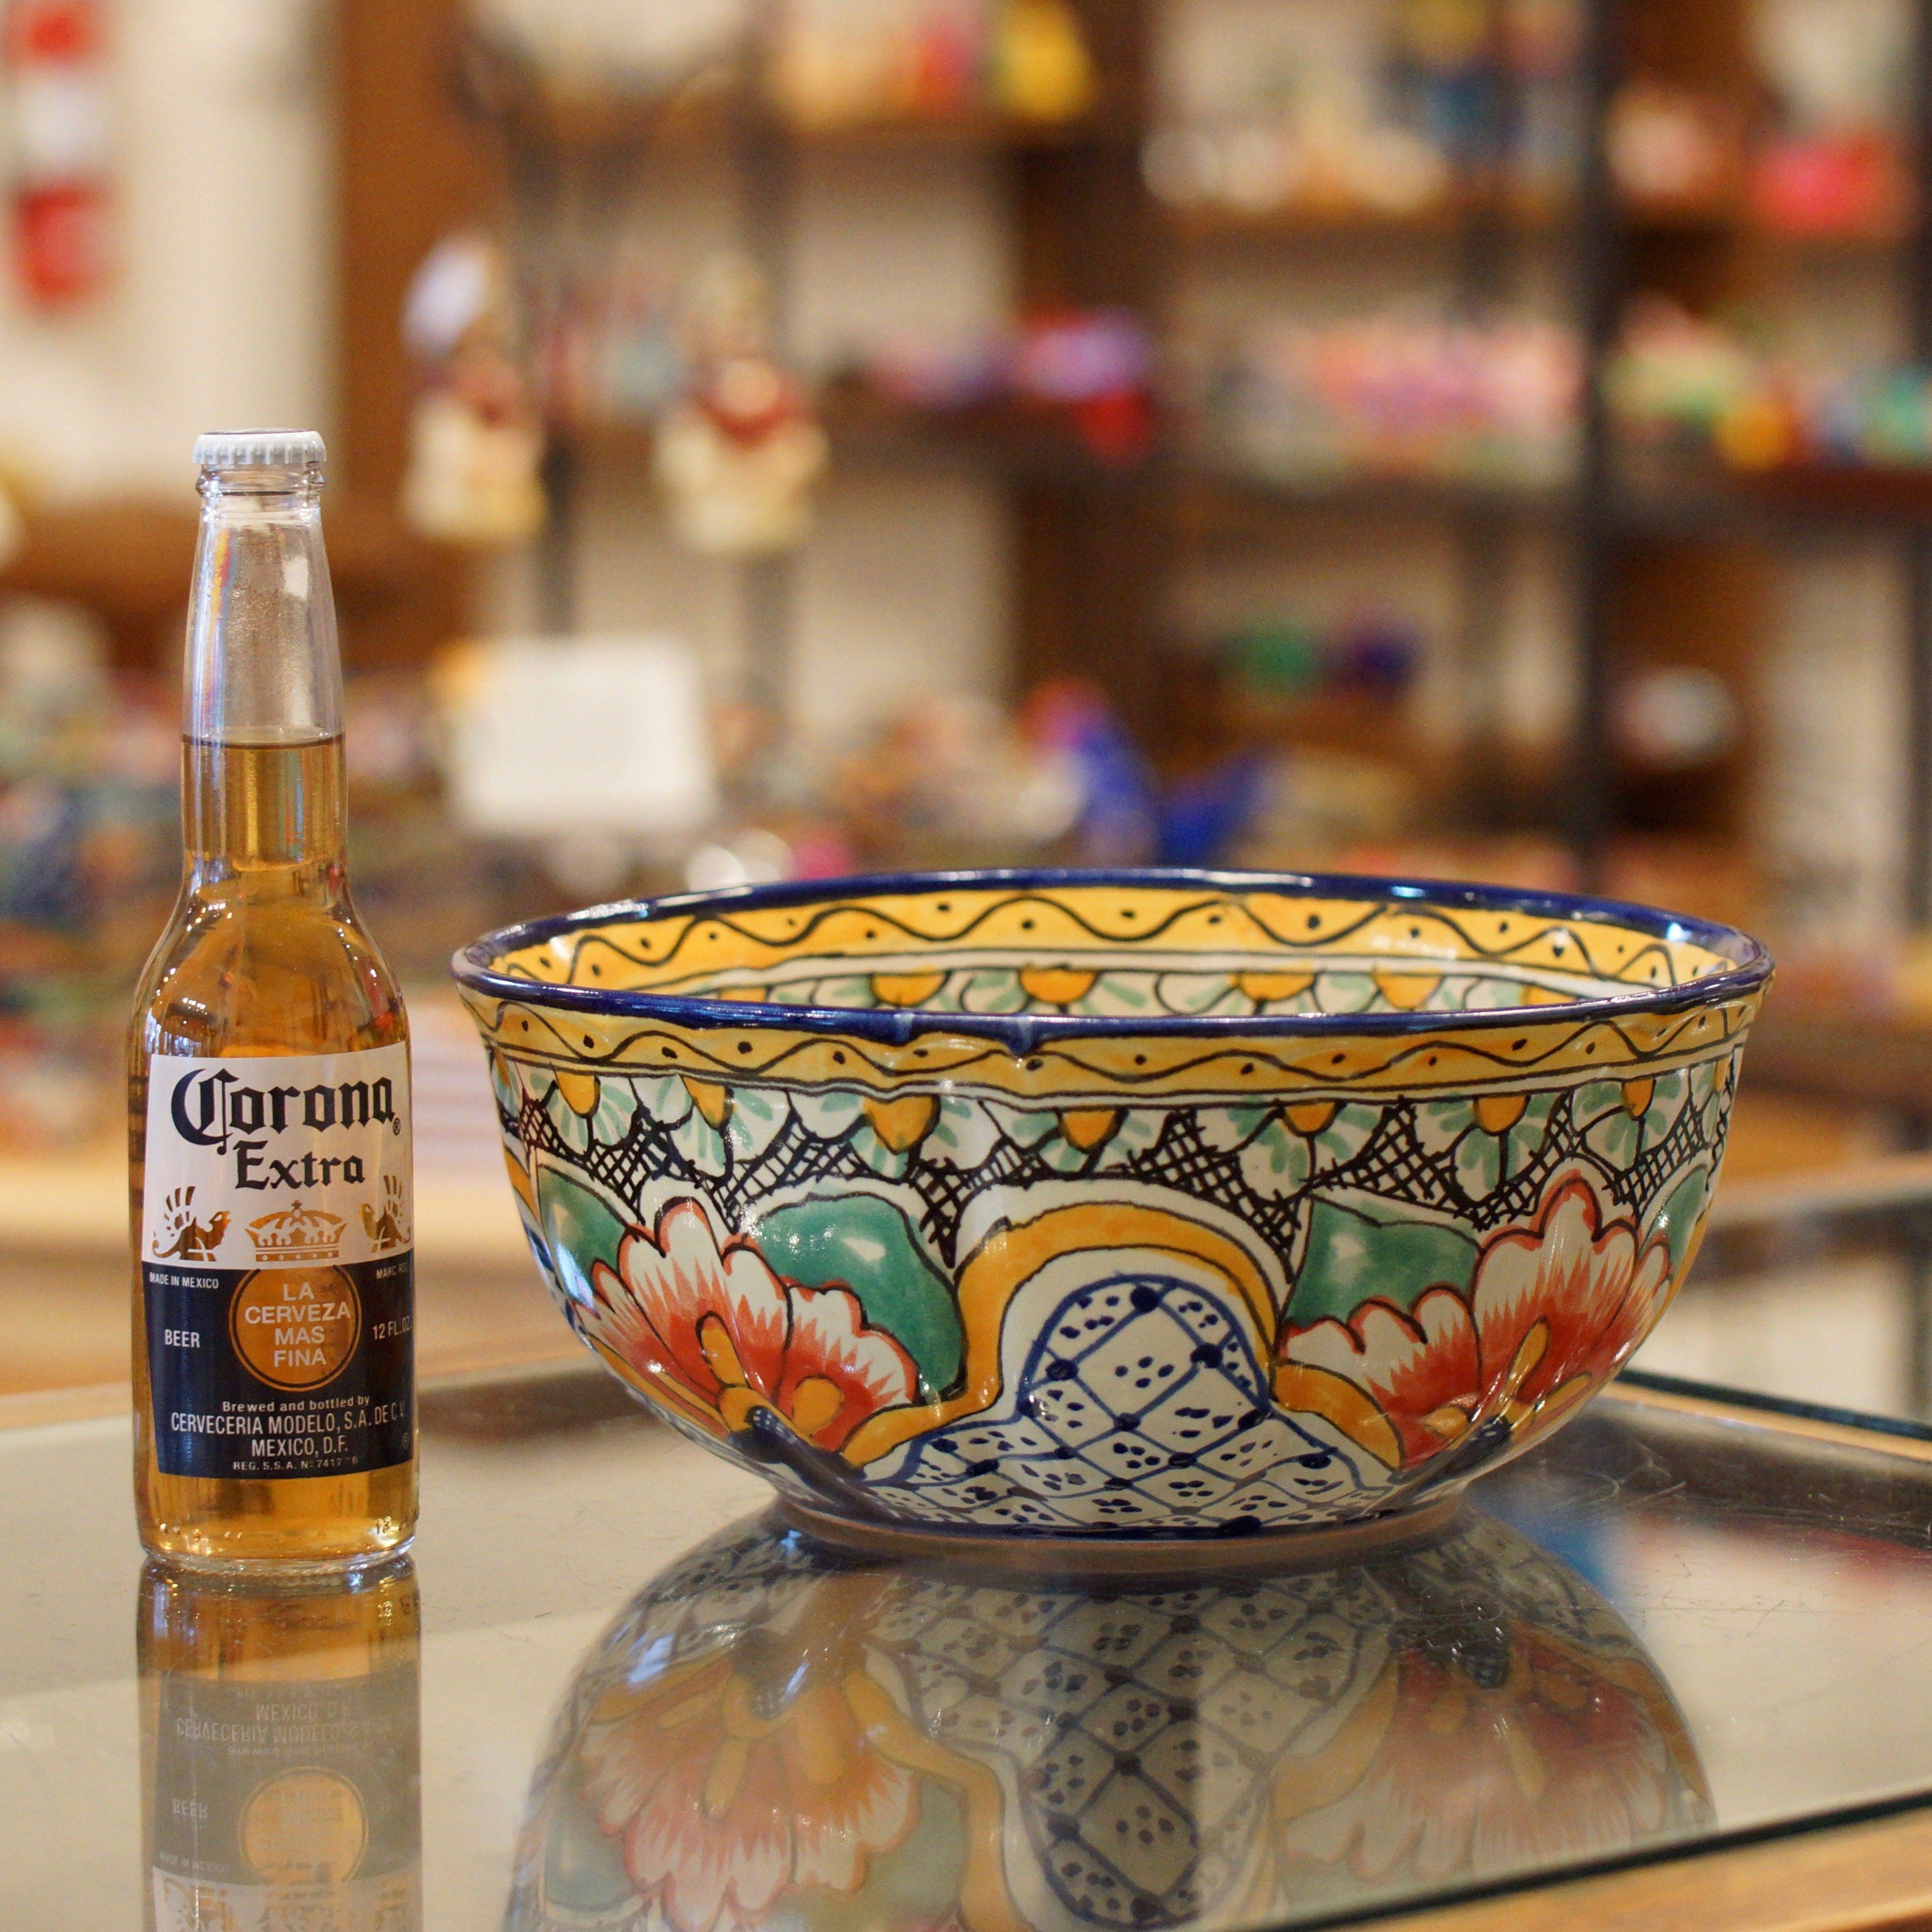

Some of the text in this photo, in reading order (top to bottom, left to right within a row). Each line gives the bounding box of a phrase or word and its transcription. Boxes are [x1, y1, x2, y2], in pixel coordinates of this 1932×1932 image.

[171, 1068, 395, 1155] Corona
[233, 1140, 366, 1190] Extra
[150, 1271, 219, 1289] MADE IN MEXICO
[283, 1282, 315, 1301] LA
[245, 1301, 351, 1324] CERVEZA
[164, 1328, 200, 1348] BEER
[275, 1326, 326, 1346] MAS
[373, 1323, 386, 1339] 12
[273, 1348, 327, 1367] FINA
[222, 1395, 369, 1413] Brewed and bottled by
[171, 1412, 264, 1435] CERVECERIA
[268, 1413, 340, 1434] MODELO,
[344, 1409, 372, 1430] S.A.
[374, 1404, 389, 1425] DE
[251, 1435, 348, 1458] MEXICO, D.F.
[233, 1461, 260, 1471] REG.
